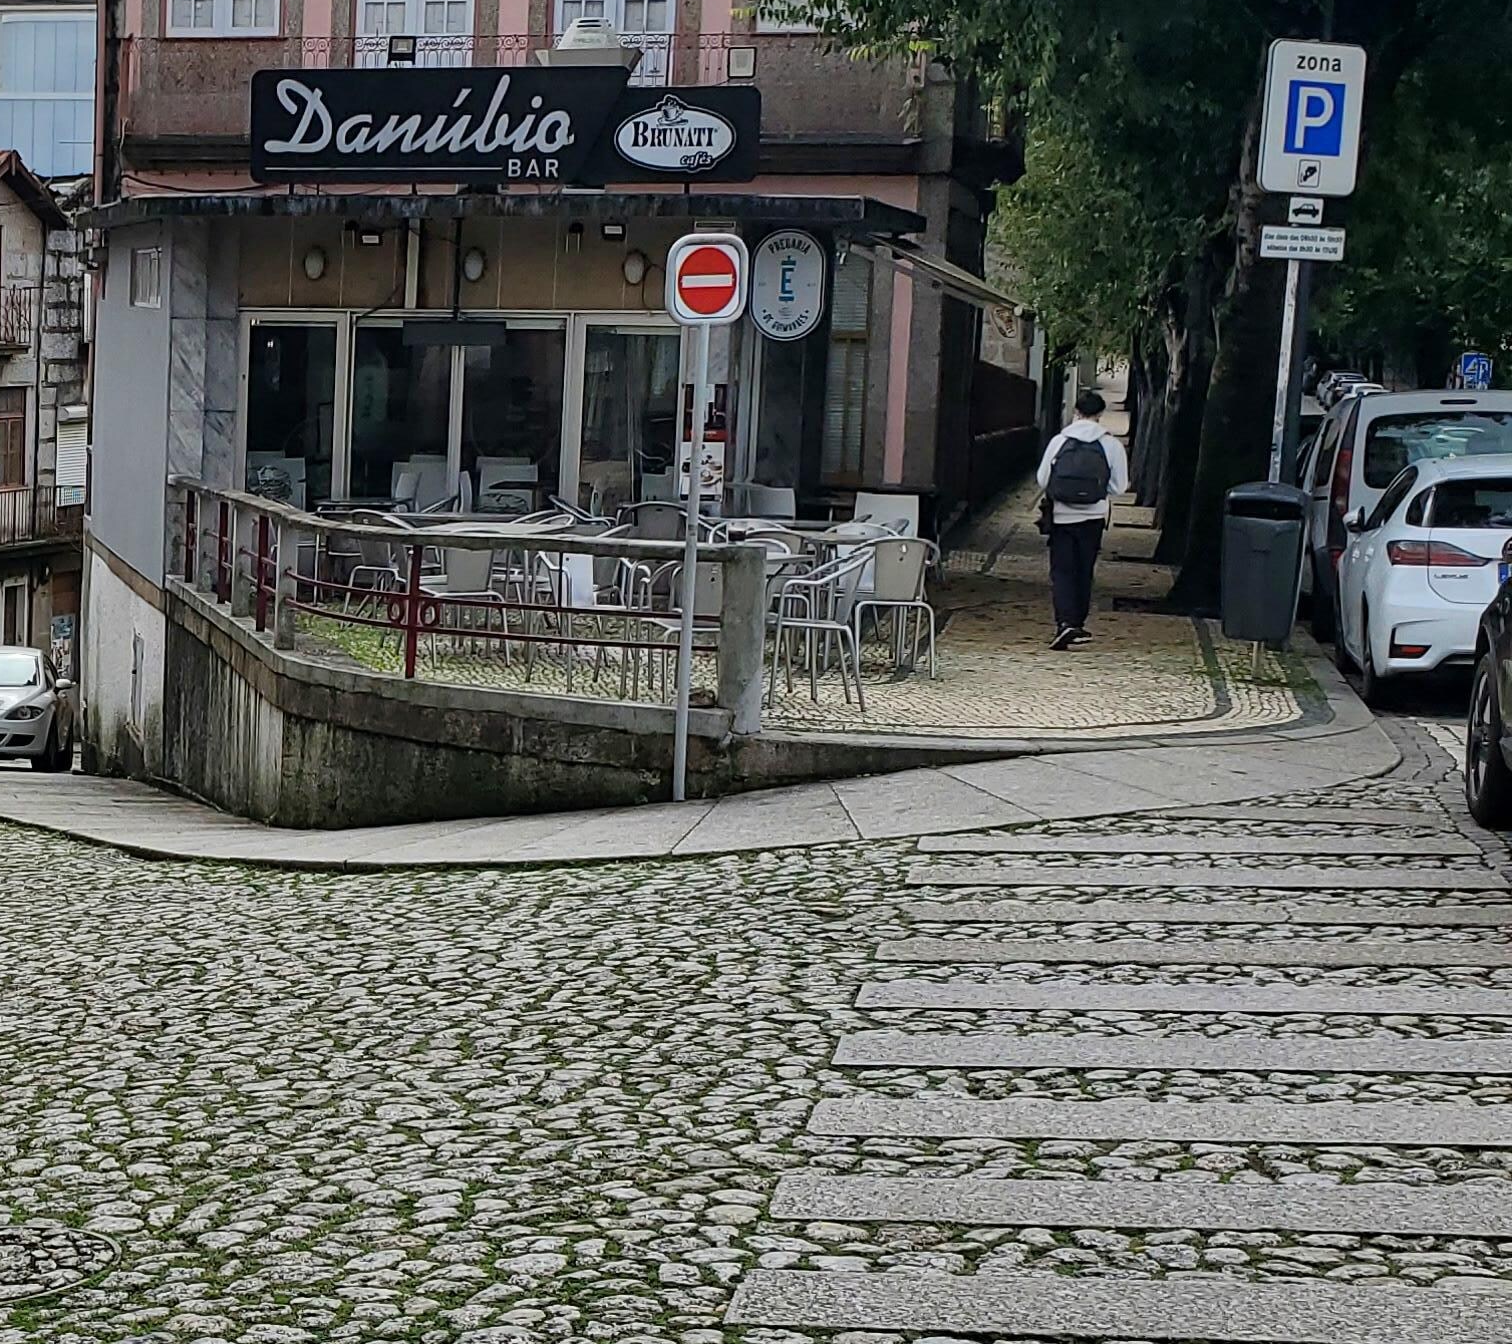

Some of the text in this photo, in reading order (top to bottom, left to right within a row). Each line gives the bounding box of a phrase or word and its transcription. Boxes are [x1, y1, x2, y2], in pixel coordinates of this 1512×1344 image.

[1296, 55, 1342, 72] zona
[264, 74, 575, 154] Danúbio
[1294, 86, 1335, 149] P
[631, 121, 714, 148] BRUNATI
[507, 158, 559, 178] BAR
[680, 151, 713, 168] cafés
